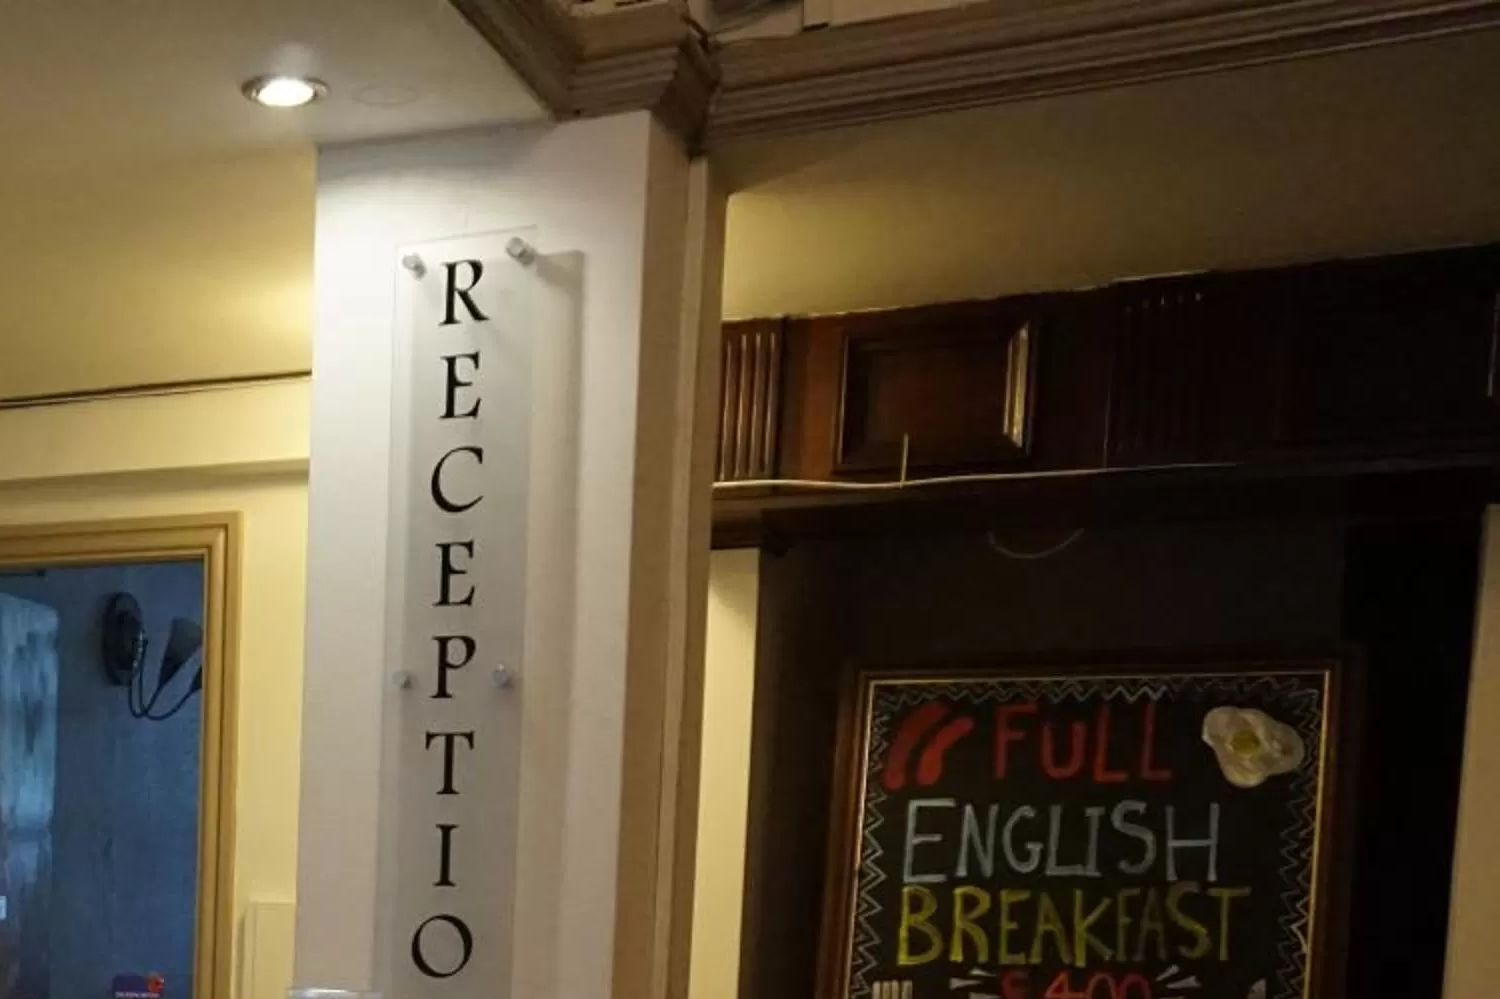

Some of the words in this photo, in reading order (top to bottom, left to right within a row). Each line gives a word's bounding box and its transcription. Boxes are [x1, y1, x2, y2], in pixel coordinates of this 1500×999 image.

[992, 701, 1173, 783] FULL
[903, 798, 1221, 882] ENGLISH
[896, 883, 1252, 967] BREAKFAST
